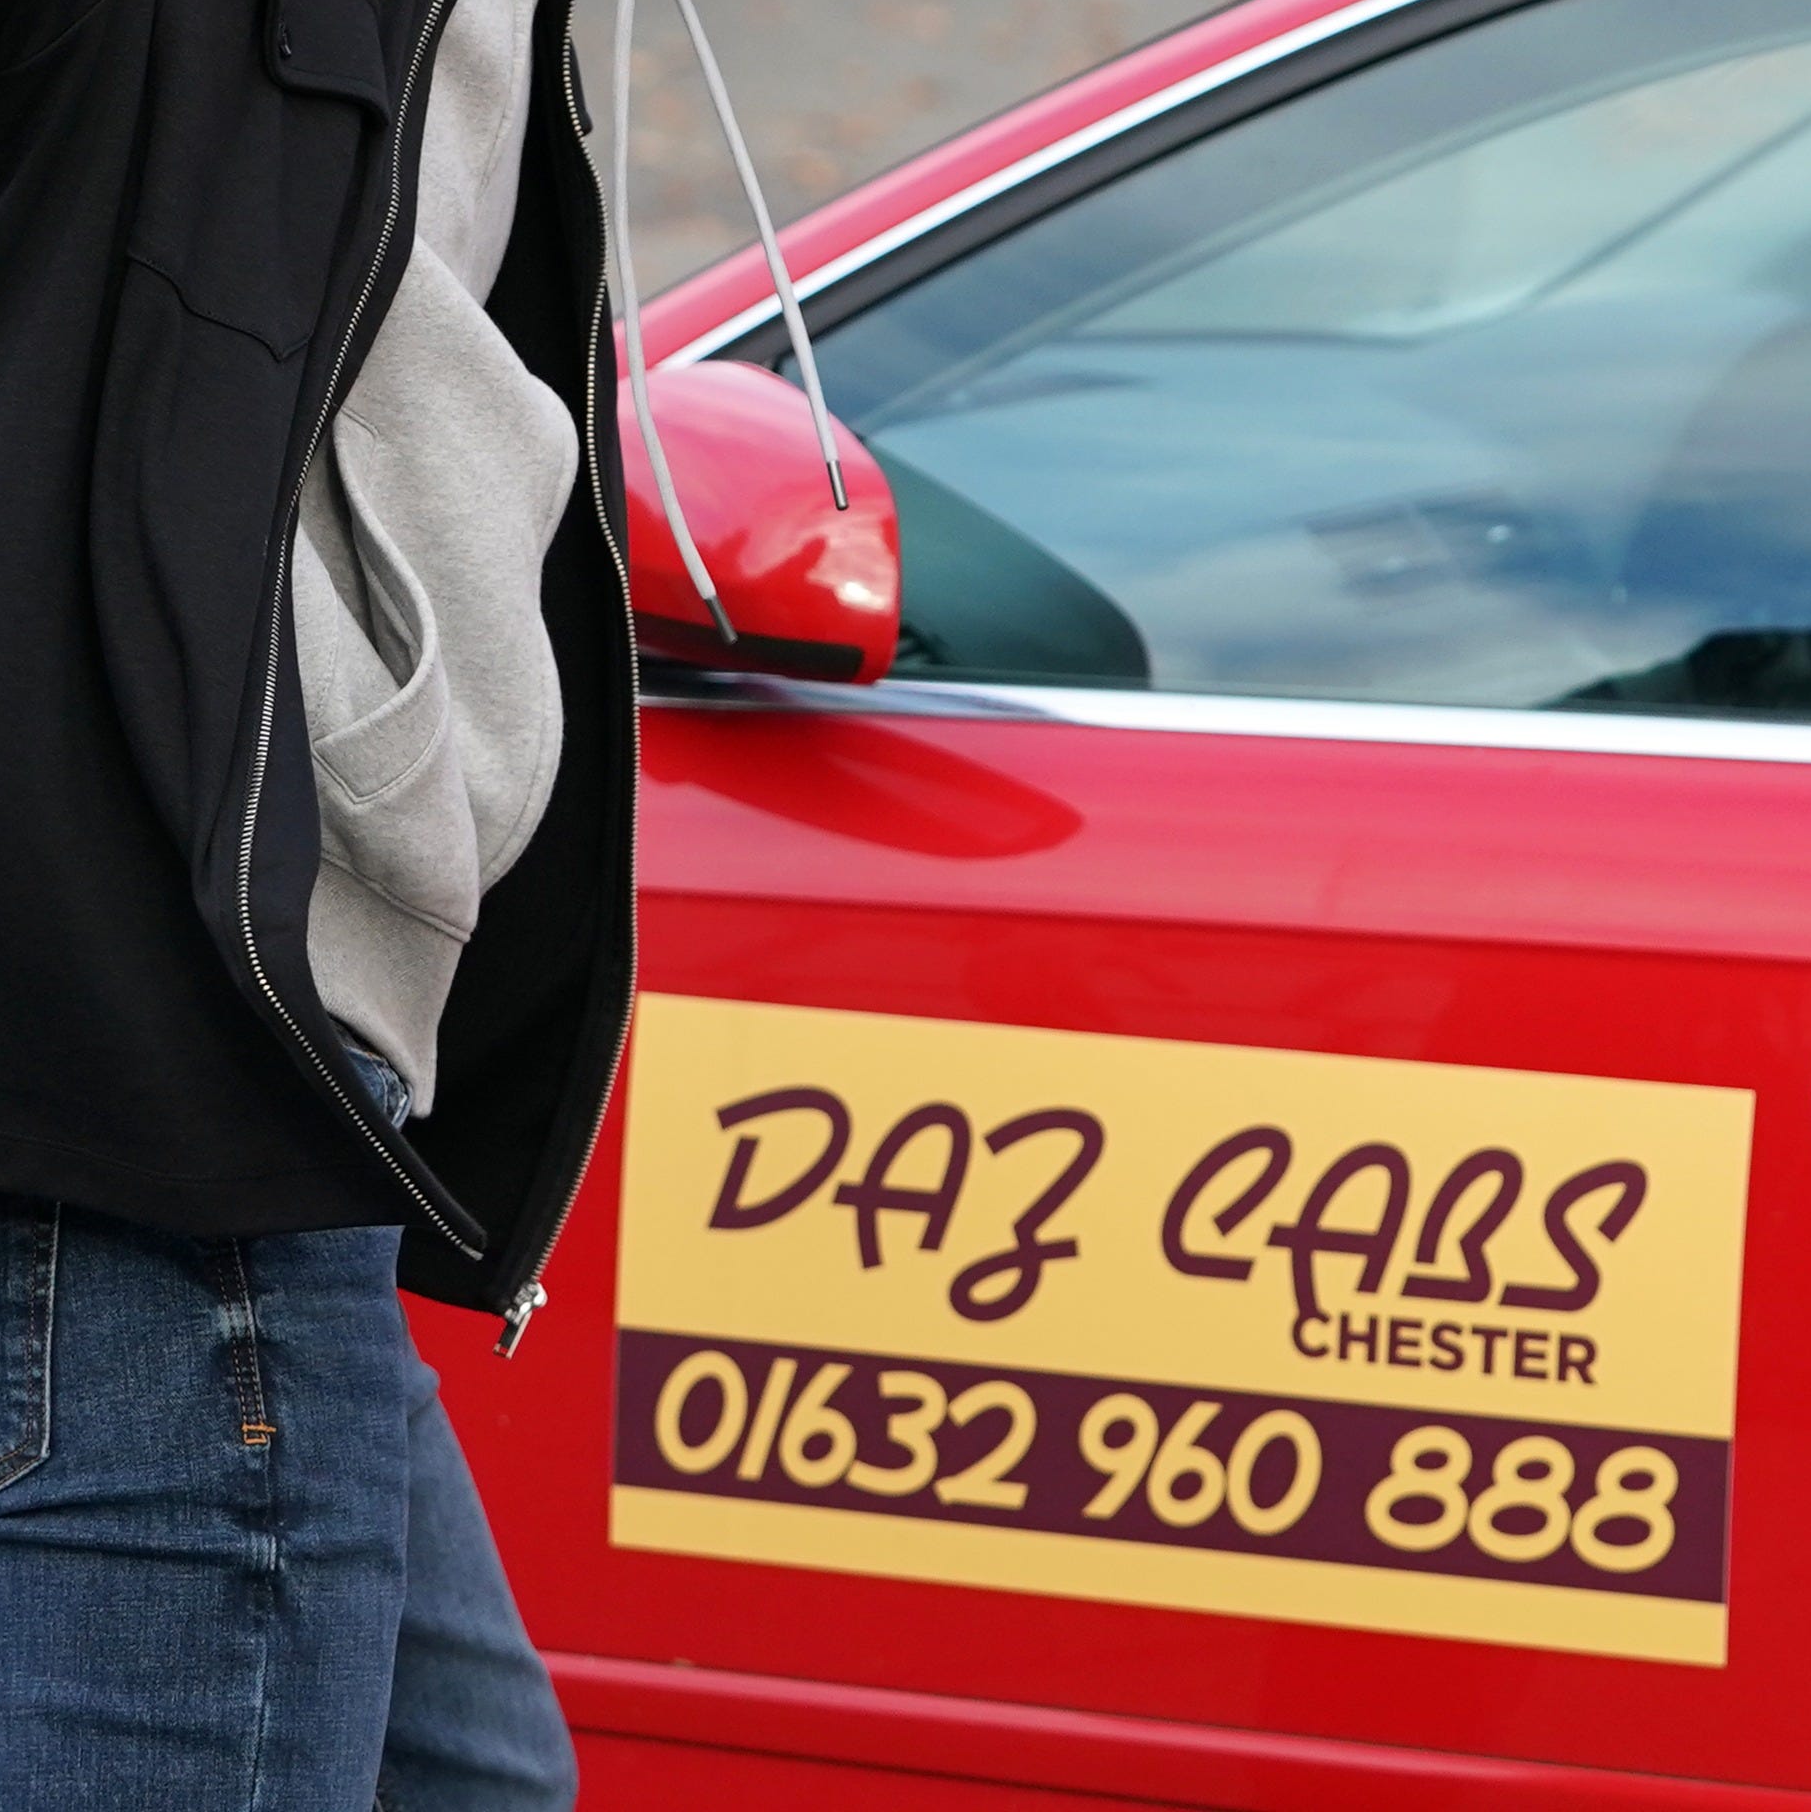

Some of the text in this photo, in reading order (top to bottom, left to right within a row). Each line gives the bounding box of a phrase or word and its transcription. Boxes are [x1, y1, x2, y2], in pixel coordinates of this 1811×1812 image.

[707, 1086, 1648, 1323] DAZ CABS
[1290, 1308, 1598, 1386] CHESTER
[655, 1350, 1679, 1573] 01632 960 888
